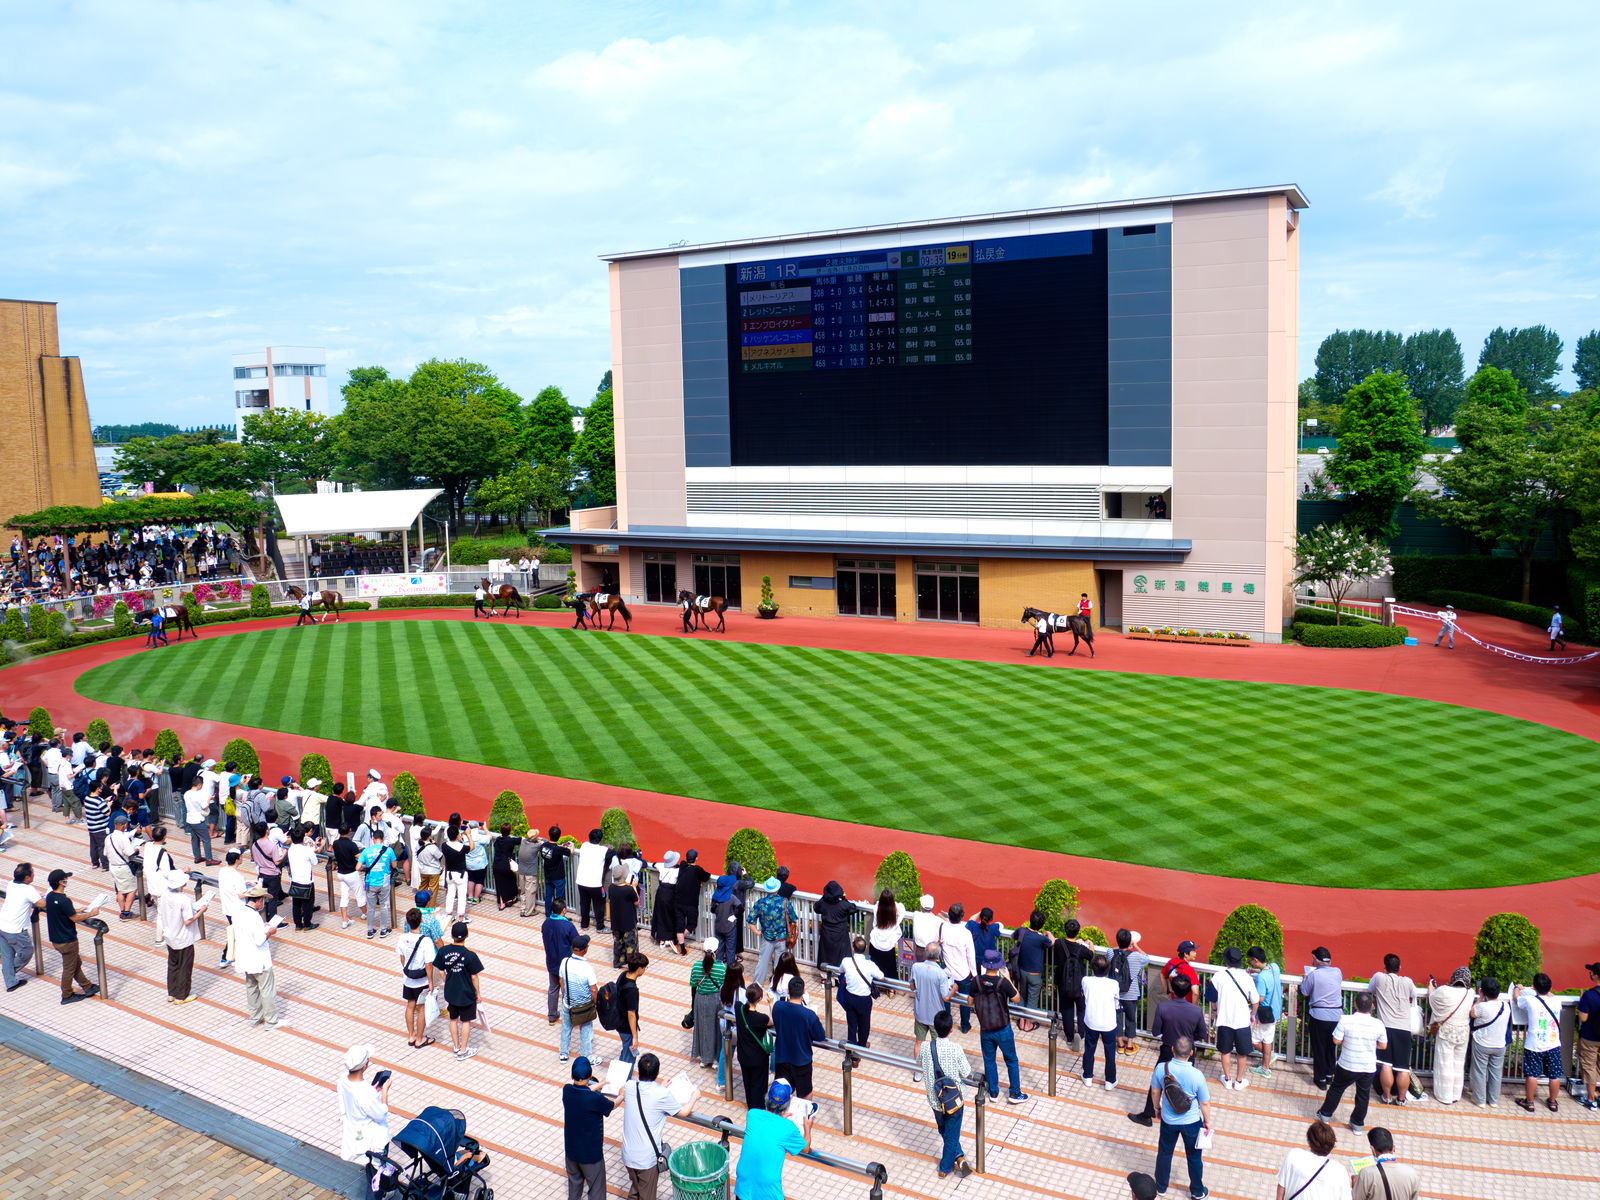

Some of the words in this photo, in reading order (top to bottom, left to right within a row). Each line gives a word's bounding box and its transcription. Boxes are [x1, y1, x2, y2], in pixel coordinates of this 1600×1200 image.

[921, 255, 944, 266] 09:35
[975, 247, 1005, 261] 払戻金
[740, 265, 766, 281] 新潟
[776, 264, 797, 278] 1R
